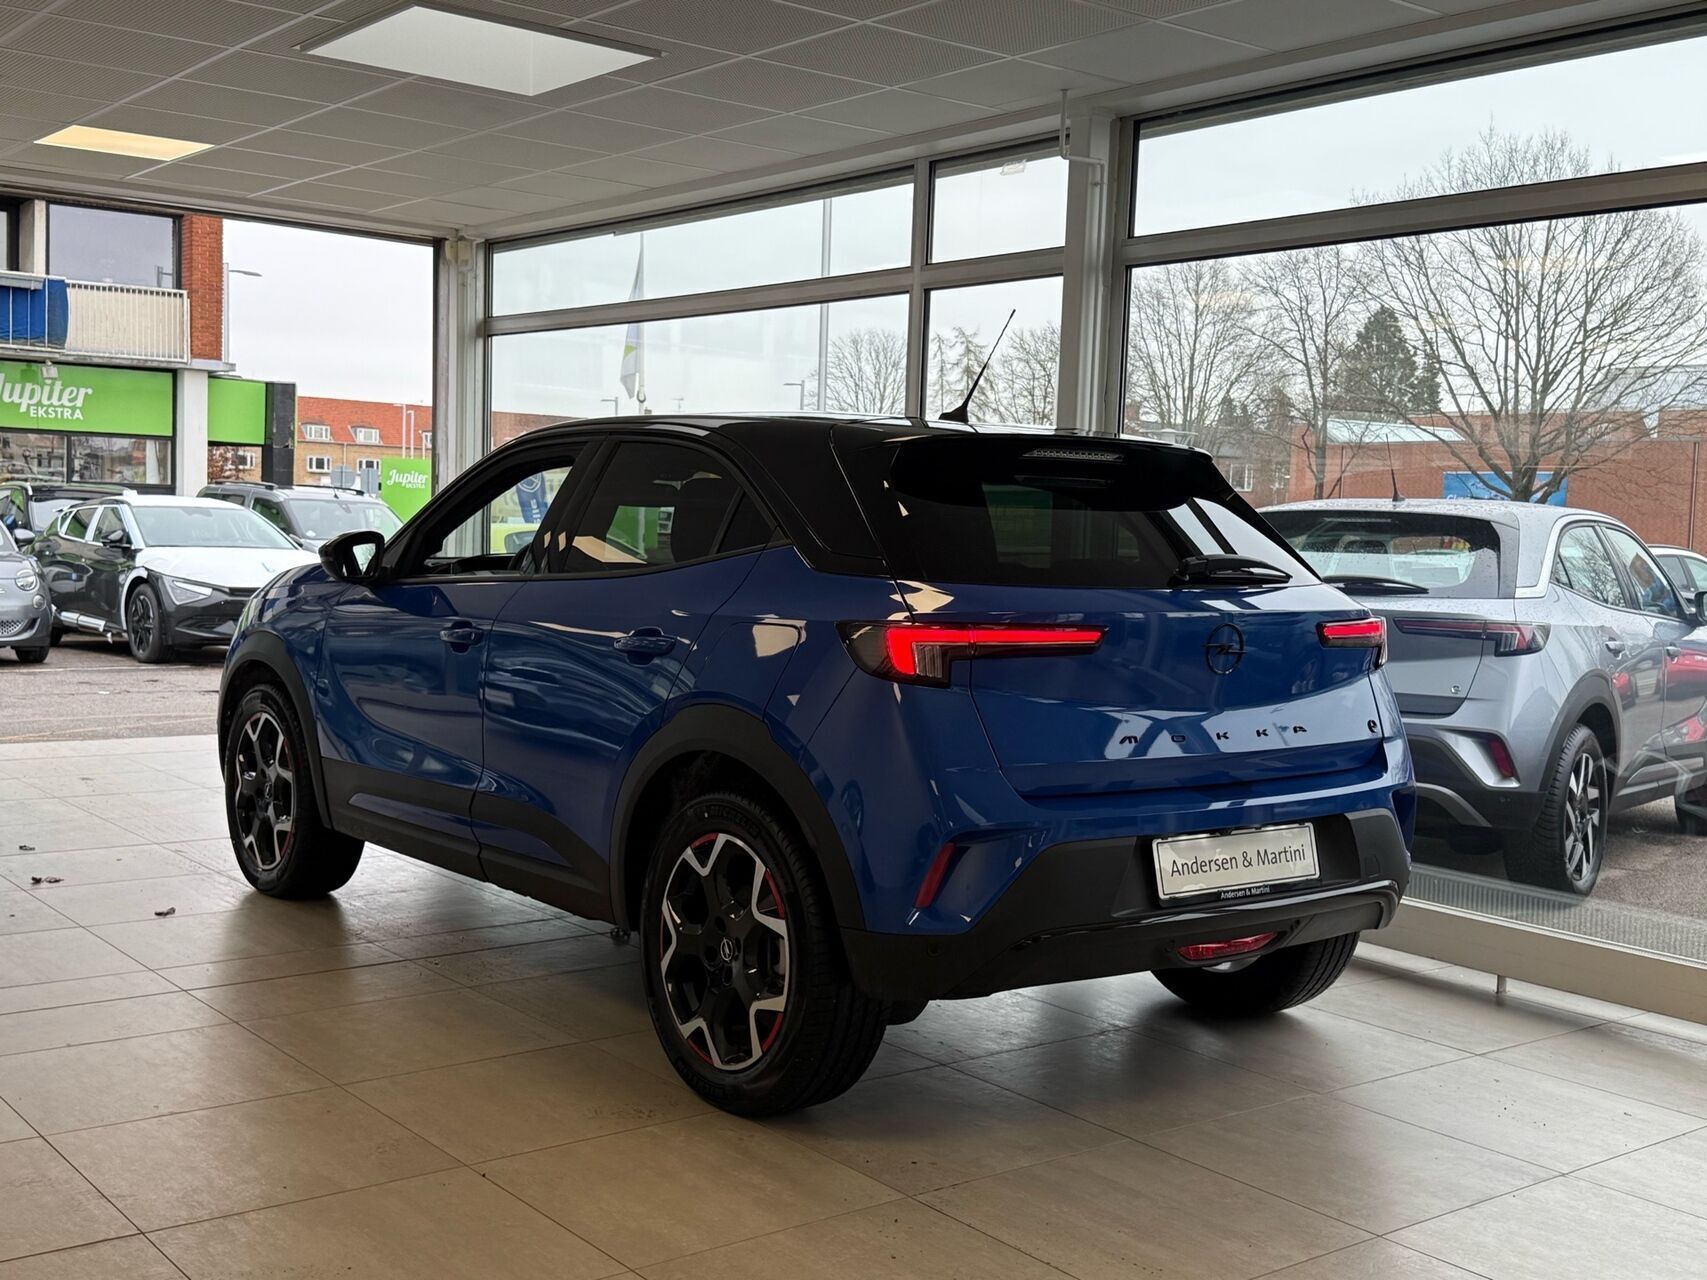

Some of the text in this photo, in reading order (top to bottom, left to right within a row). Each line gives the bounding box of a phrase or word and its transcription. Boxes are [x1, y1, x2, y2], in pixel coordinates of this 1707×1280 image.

[30, 406, 83, 420] EKSTRA
[387, 469, 428, 486] Jupiter
[1119, 725, 1307, 744] MOKKA
[1171, 844, 1306, 877] Andersen & Martini
[1221, 889, 1245, 899] Andersen
[1251, 884, 1270, 895] Martini
